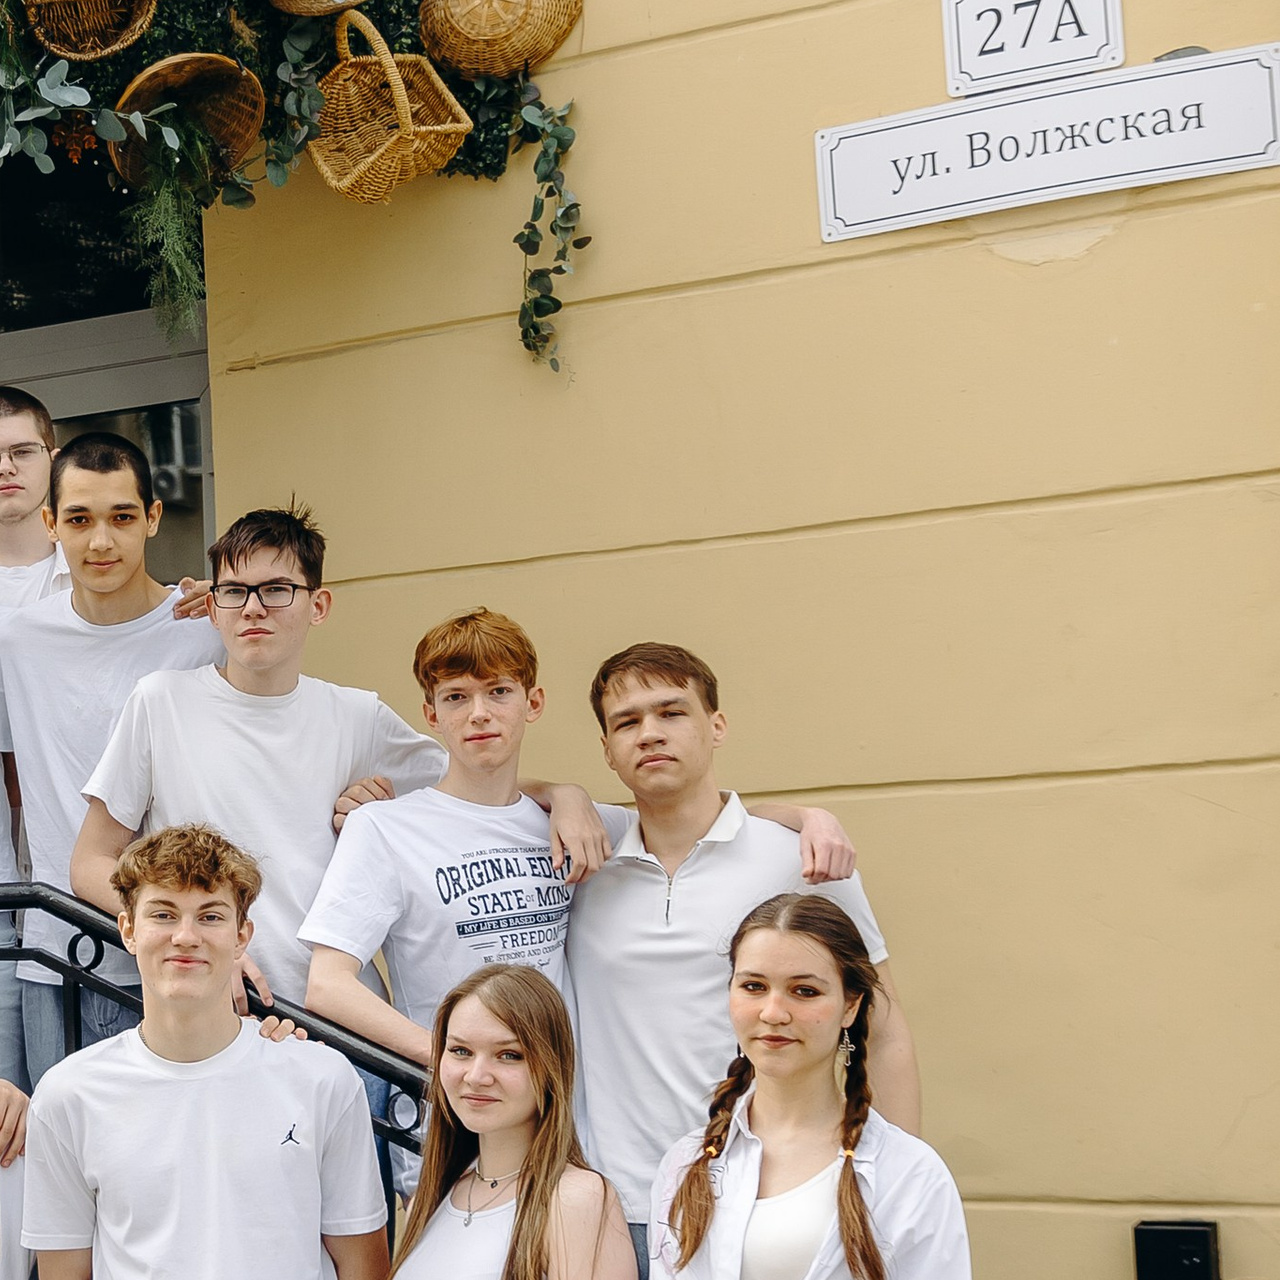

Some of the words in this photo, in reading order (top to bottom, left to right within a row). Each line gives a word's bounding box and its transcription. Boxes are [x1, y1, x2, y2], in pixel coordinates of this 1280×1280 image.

[890, 149, 952, 195] ул.
[966, 101, 1207, 170] Волжская
[461, 851, 474, 860] YOU
[488, 847, 519, 856] STRONGER
[435, 857, 527, 905] ORIGINAL
[467, 888, 528, 916] STATE
[463, 923, 478, 934] MY
[480, 921, 499, 931] LIFE
[500, 919, 508, 928] IS
[509, 915, 536, 926] BASED
[536, 913, 548, 923] ON
[497, 950, 526, 961] STRONG
[527, 947, 541, 958] AND
